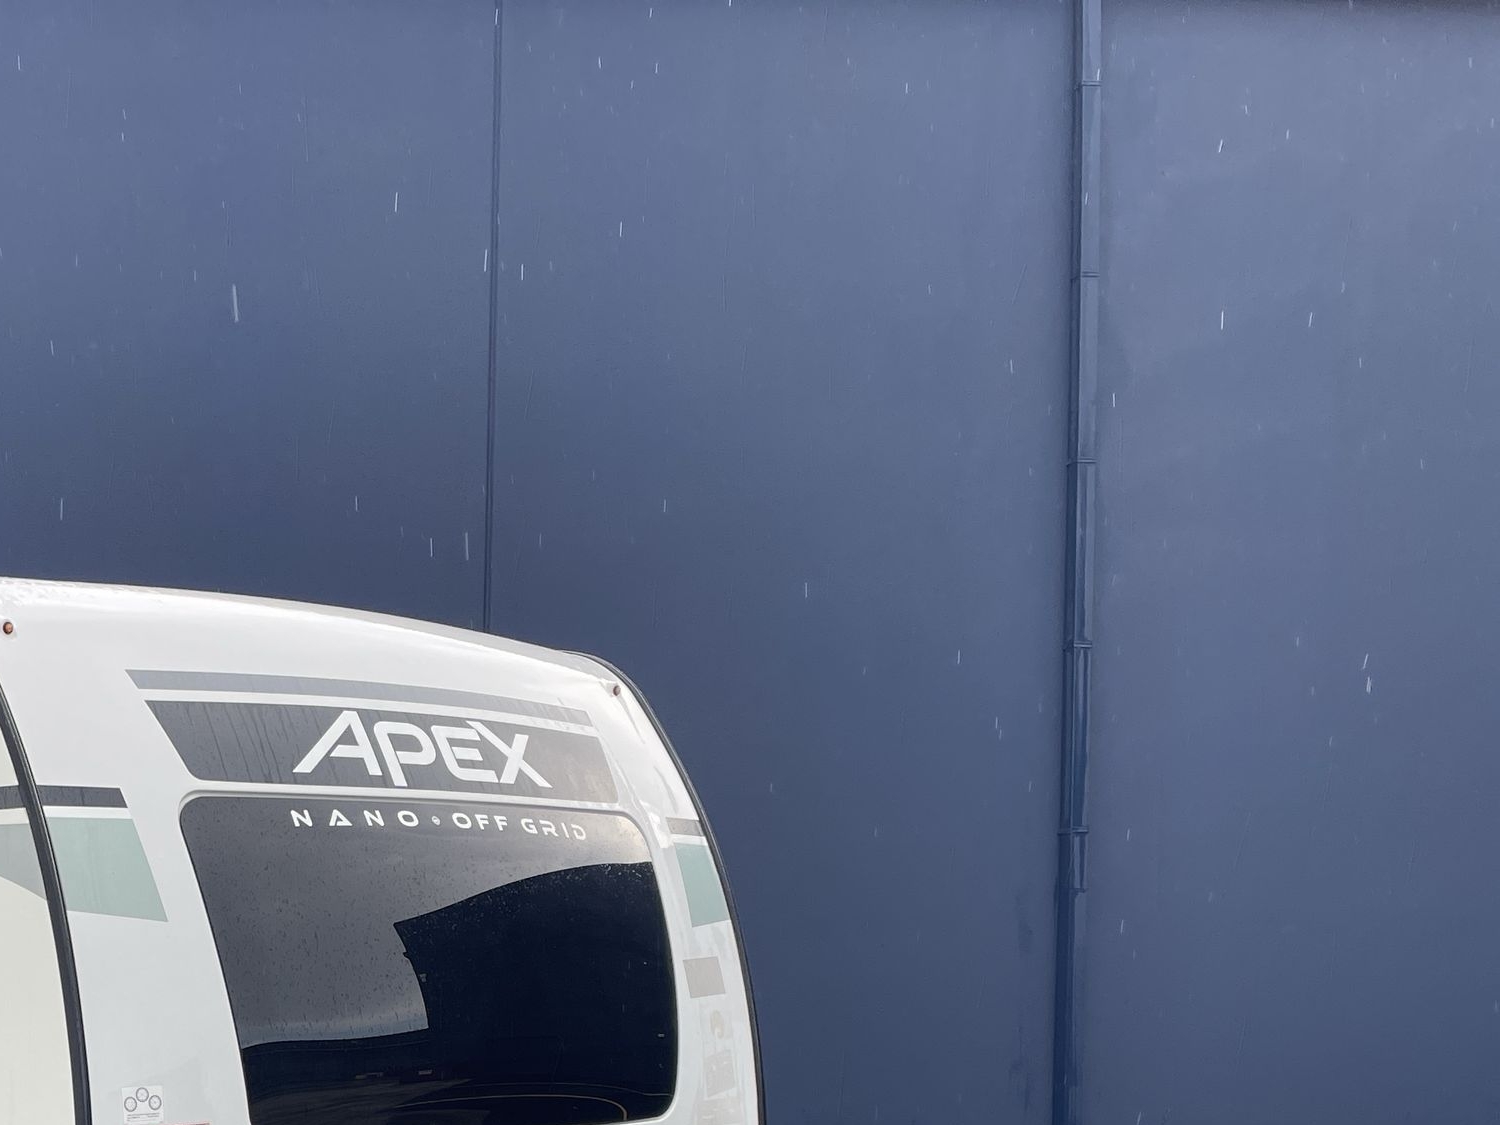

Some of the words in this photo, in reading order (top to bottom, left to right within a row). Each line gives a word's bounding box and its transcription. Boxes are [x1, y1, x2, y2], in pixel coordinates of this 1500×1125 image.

[292, 710, 553, 788] APEX
[290, 808, 420, 829] NANO
[452, 811, 508, 832] OFF
[521, 817, 588, 842] GRID
